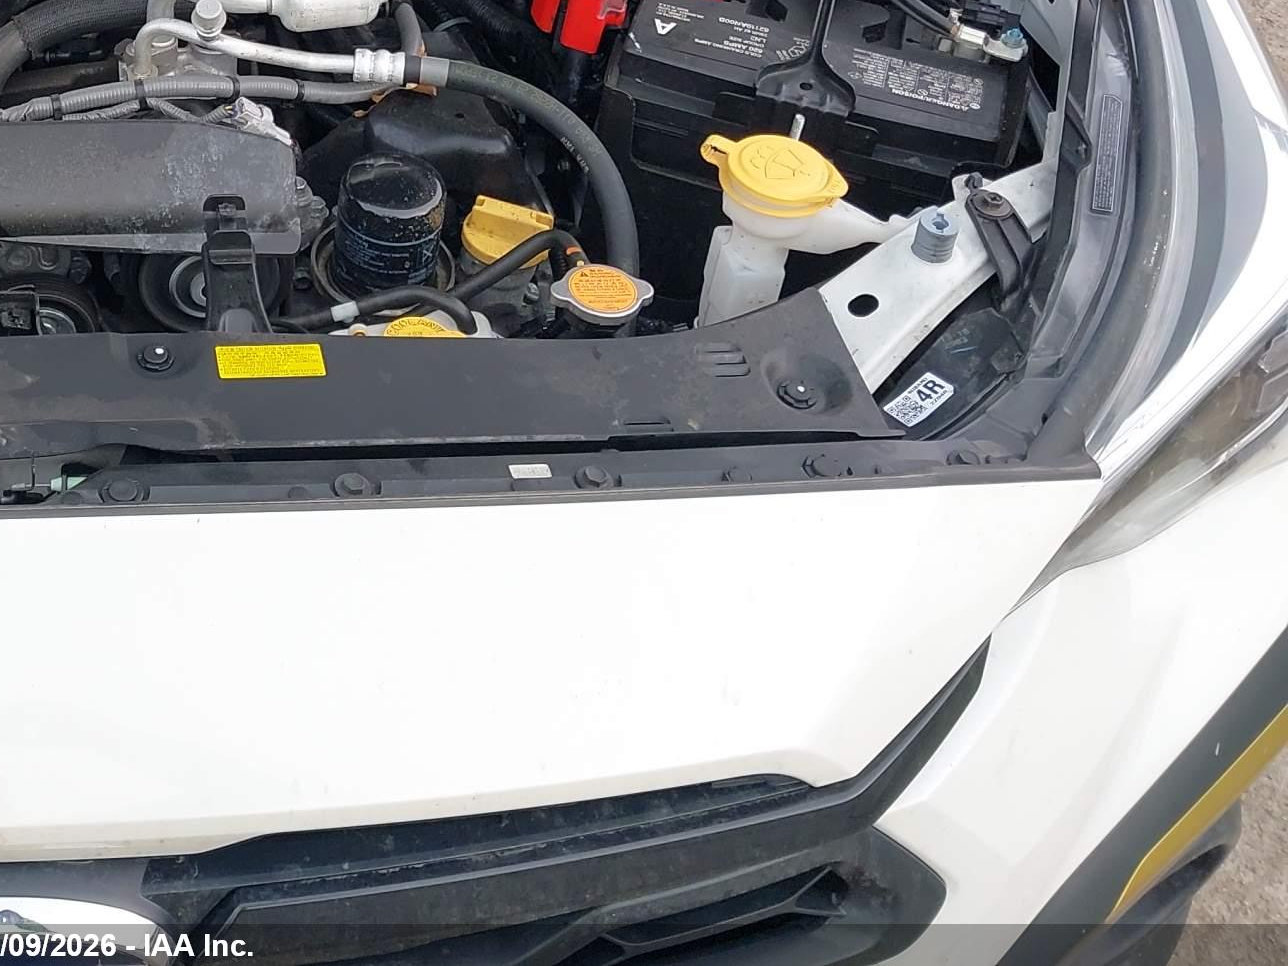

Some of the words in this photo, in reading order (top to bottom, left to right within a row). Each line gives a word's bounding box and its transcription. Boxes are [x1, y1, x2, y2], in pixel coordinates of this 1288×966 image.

[654, 18, 677, 35] A
[723, 40, 747, 51] AMPS
[916, 379, 946, 402] 4R
